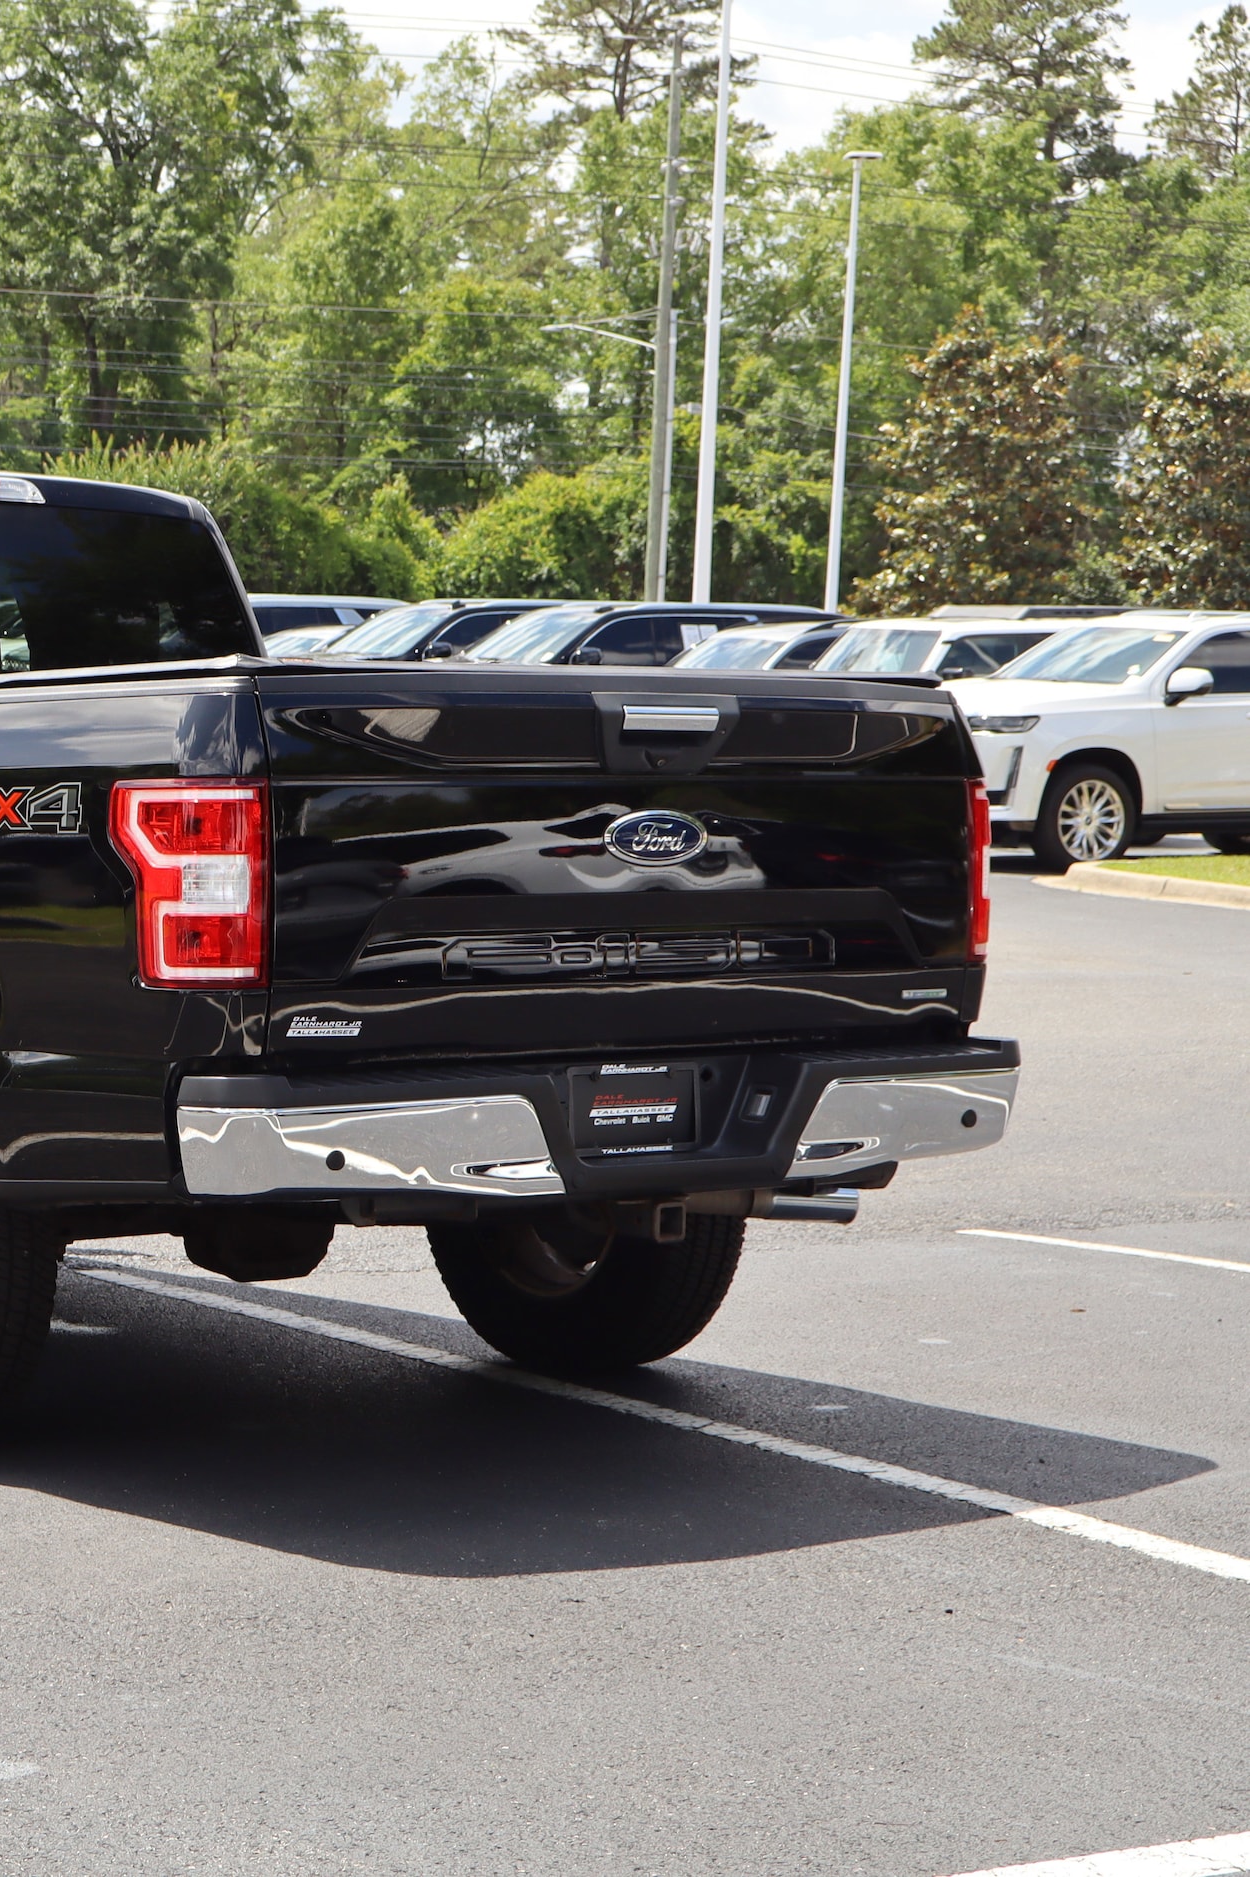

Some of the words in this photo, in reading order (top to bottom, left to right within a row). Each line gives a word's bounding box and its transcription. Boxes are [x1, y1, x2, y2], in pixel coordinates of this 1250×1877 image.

[632, 821, 687, 852] Ford
[596, 1107, 670, 1115] TALLAHASSEE
[594, 1117, 626, 1126] Chevrolet
[632, 1116, 650, 1124] Buick
[656, 1114, 674, 1122] GMC
[601, 1145, 674, 1154] TALLAHASSEE
